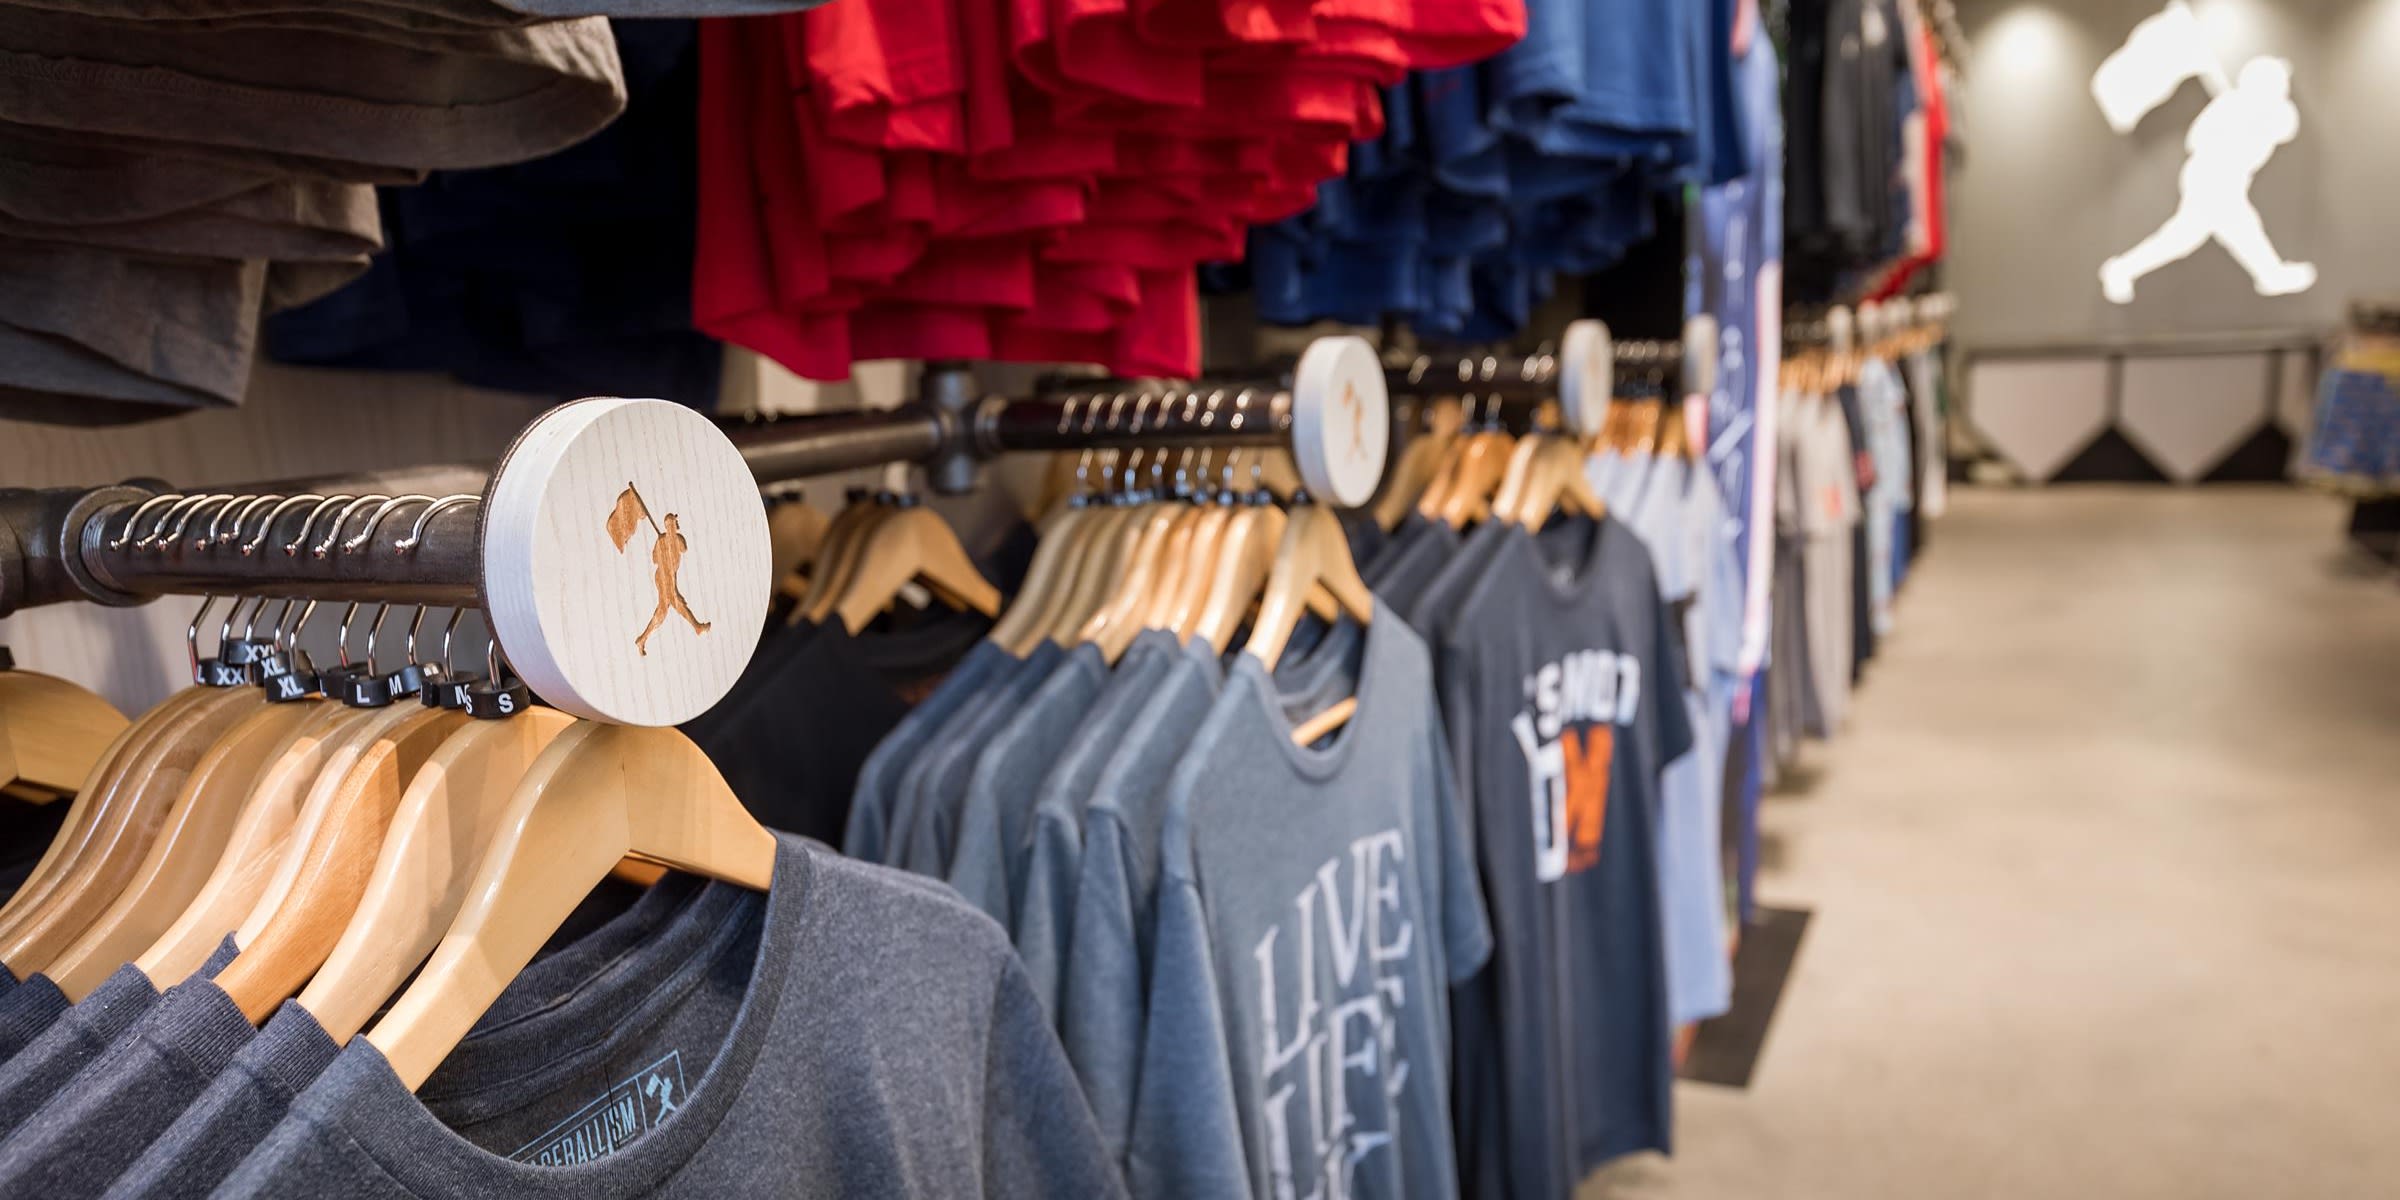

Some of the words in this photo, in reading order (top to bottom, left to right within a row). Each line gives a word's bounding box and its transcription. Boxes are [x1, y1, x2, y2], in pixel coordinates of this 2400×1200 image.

[261, 656, 286, 678] XL
[277, 675, 304, 698] XL
[355, 684, 370, 703] L
[389, 674, 403, 696] M
[498, 692, 514, 714] S
[1254, 827, 1413, 1078] LIVE
